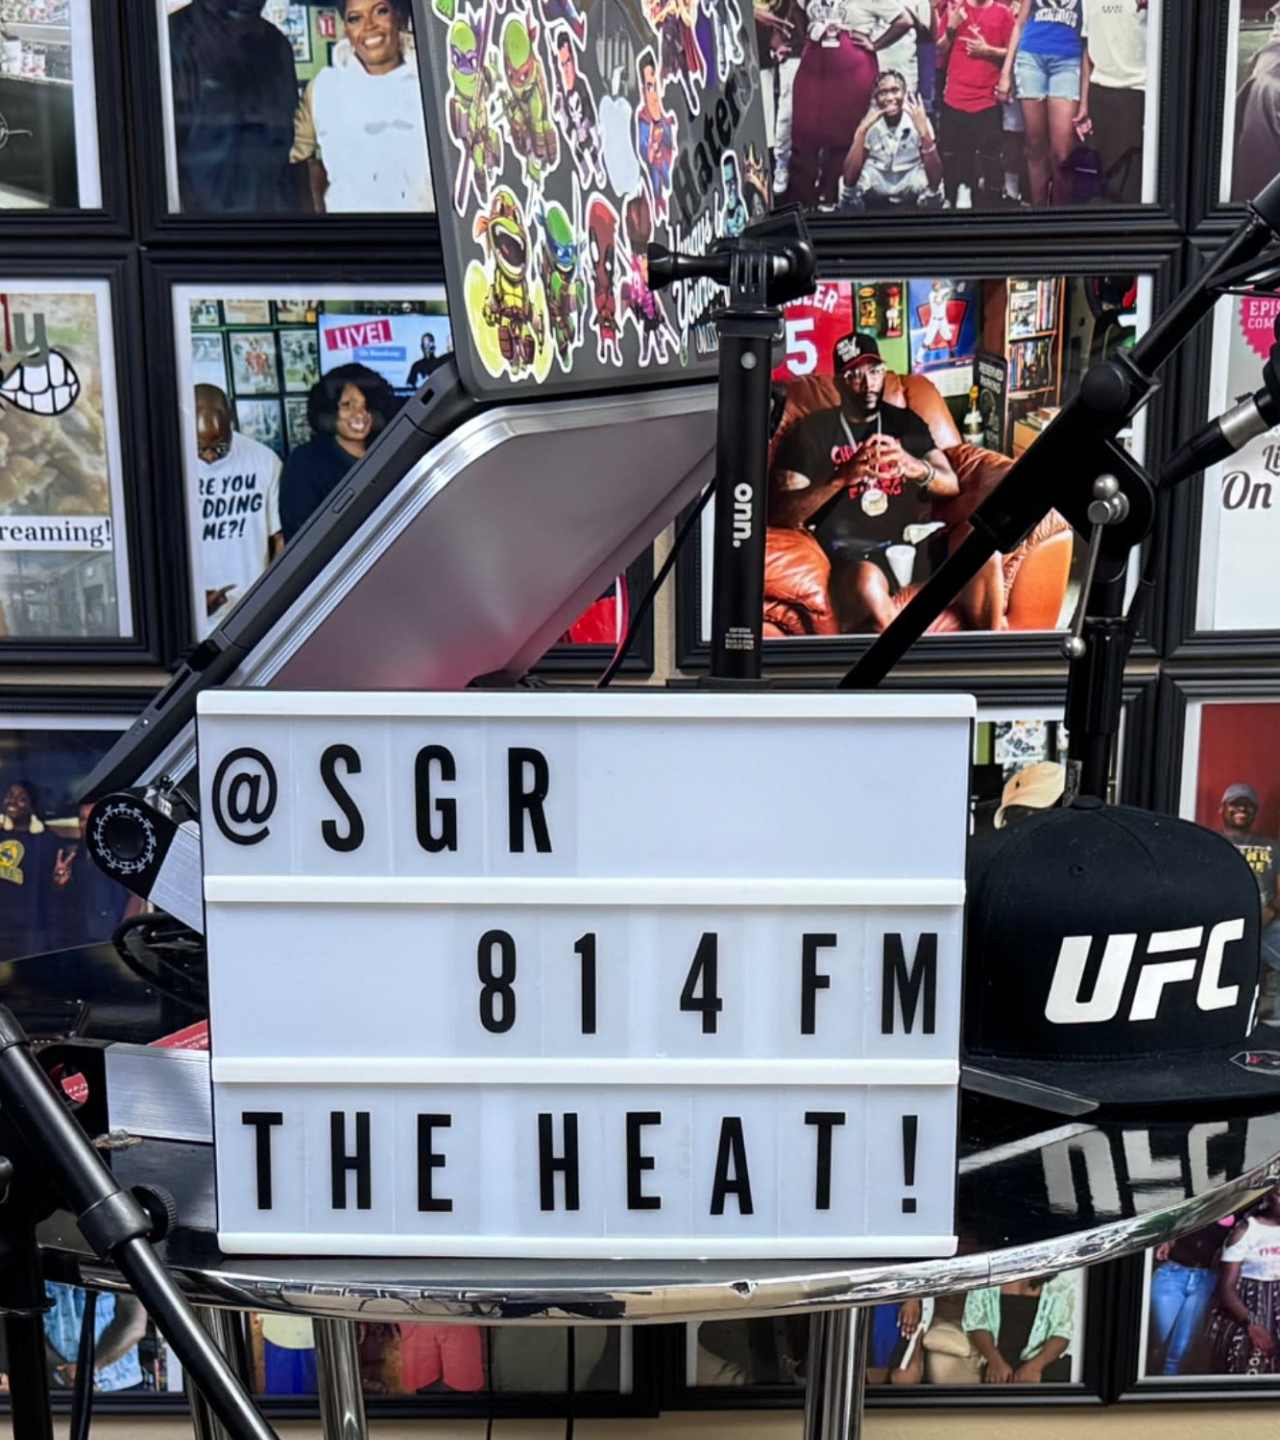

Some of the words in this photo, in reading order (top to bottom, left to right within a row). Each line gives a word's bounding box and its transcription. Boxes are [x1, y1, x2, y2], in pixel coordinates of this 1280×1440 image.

[333, 322, 388, 350] LIVE!
[786, 317, 819, 377] 5
[202, 493, 263, 520] DDING
[221, 472, 257, 493] YOU
[1222, 469, 1273, 510] On
[202, 518, 246, 541] ME?!
[732, 482, 754, 549] onn.
[211, 744, 553, 855] @SGR
[1043, 917, 1246, 1025] UFC
[241, 1111, 454, 1212] THE
[537, 1111, 919, 1216] HEAT!
